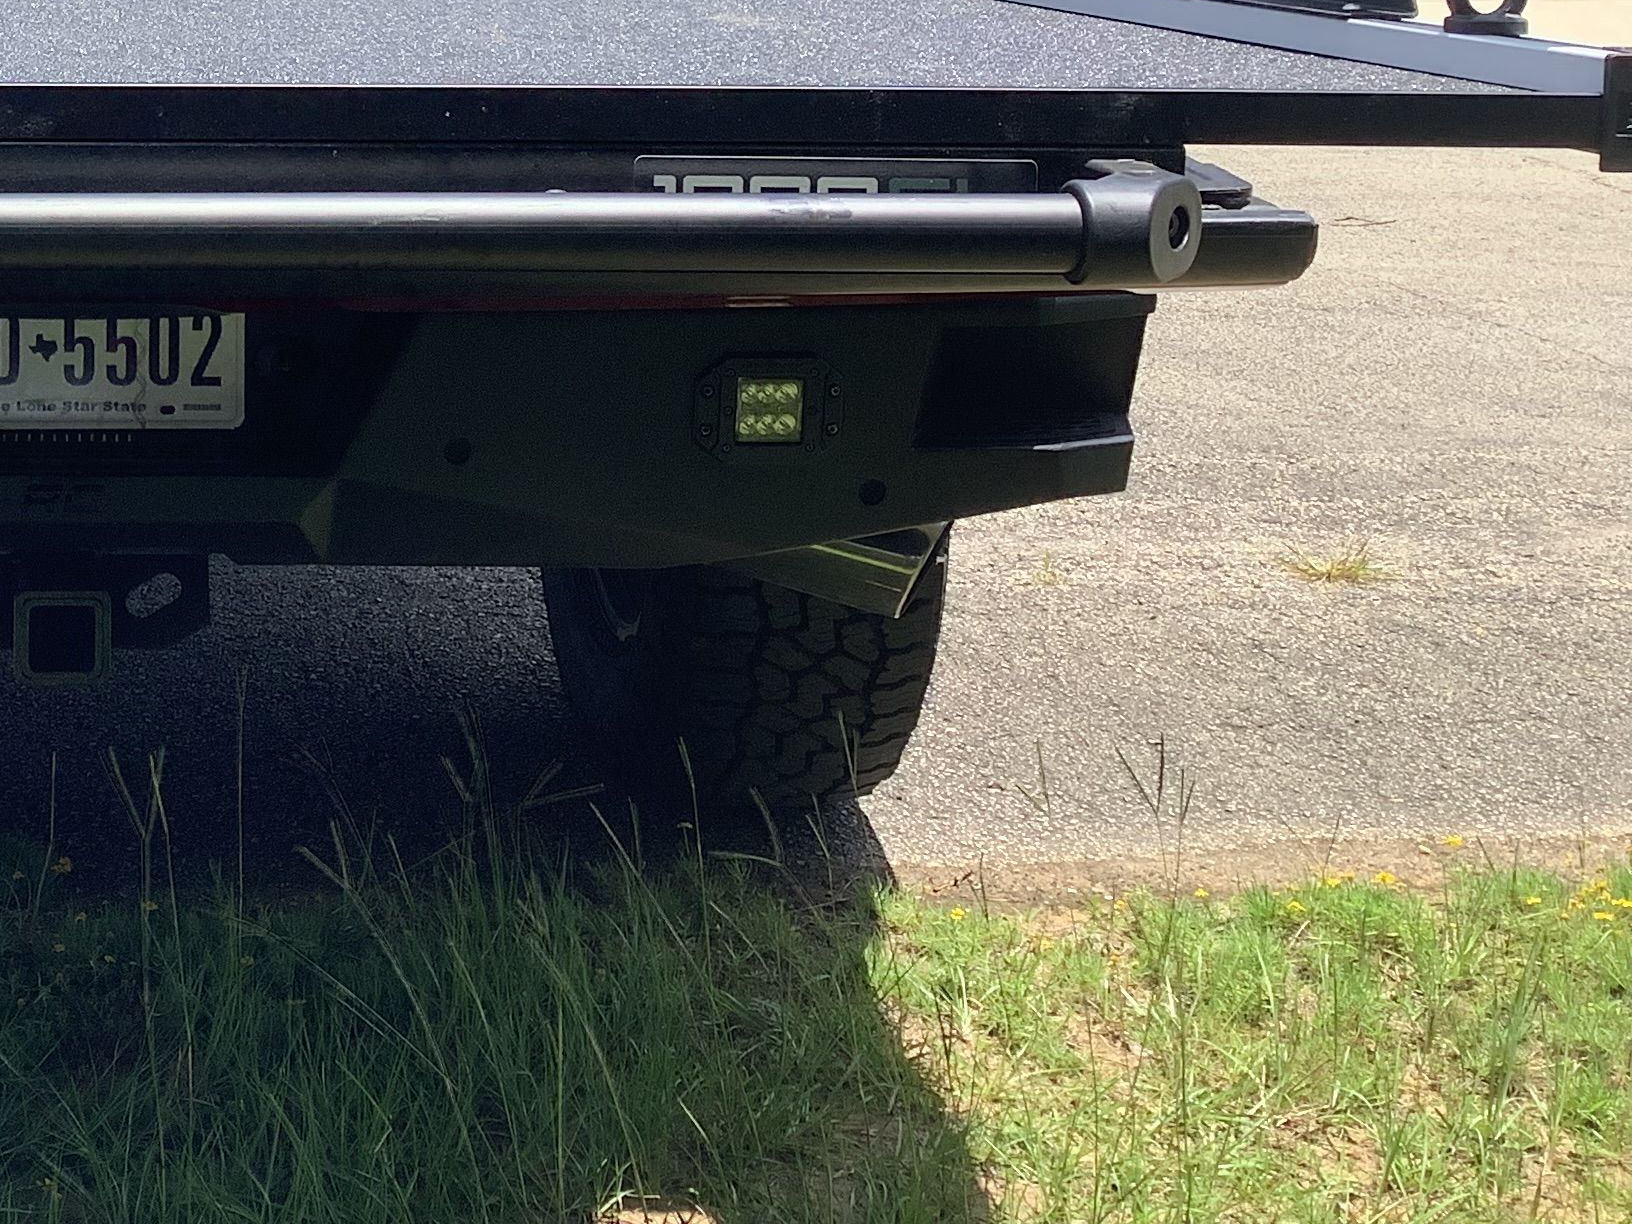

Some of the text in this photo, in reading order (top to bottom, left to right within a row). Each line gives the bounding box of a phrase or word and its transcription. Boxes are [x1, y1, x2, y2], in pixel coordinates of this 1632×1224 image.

[63, 314, 222, 387] 5502
[17, 400, 56, 412] Lone
[62, 400, 97, 412] Star
[102, 400, 146, 412] State
